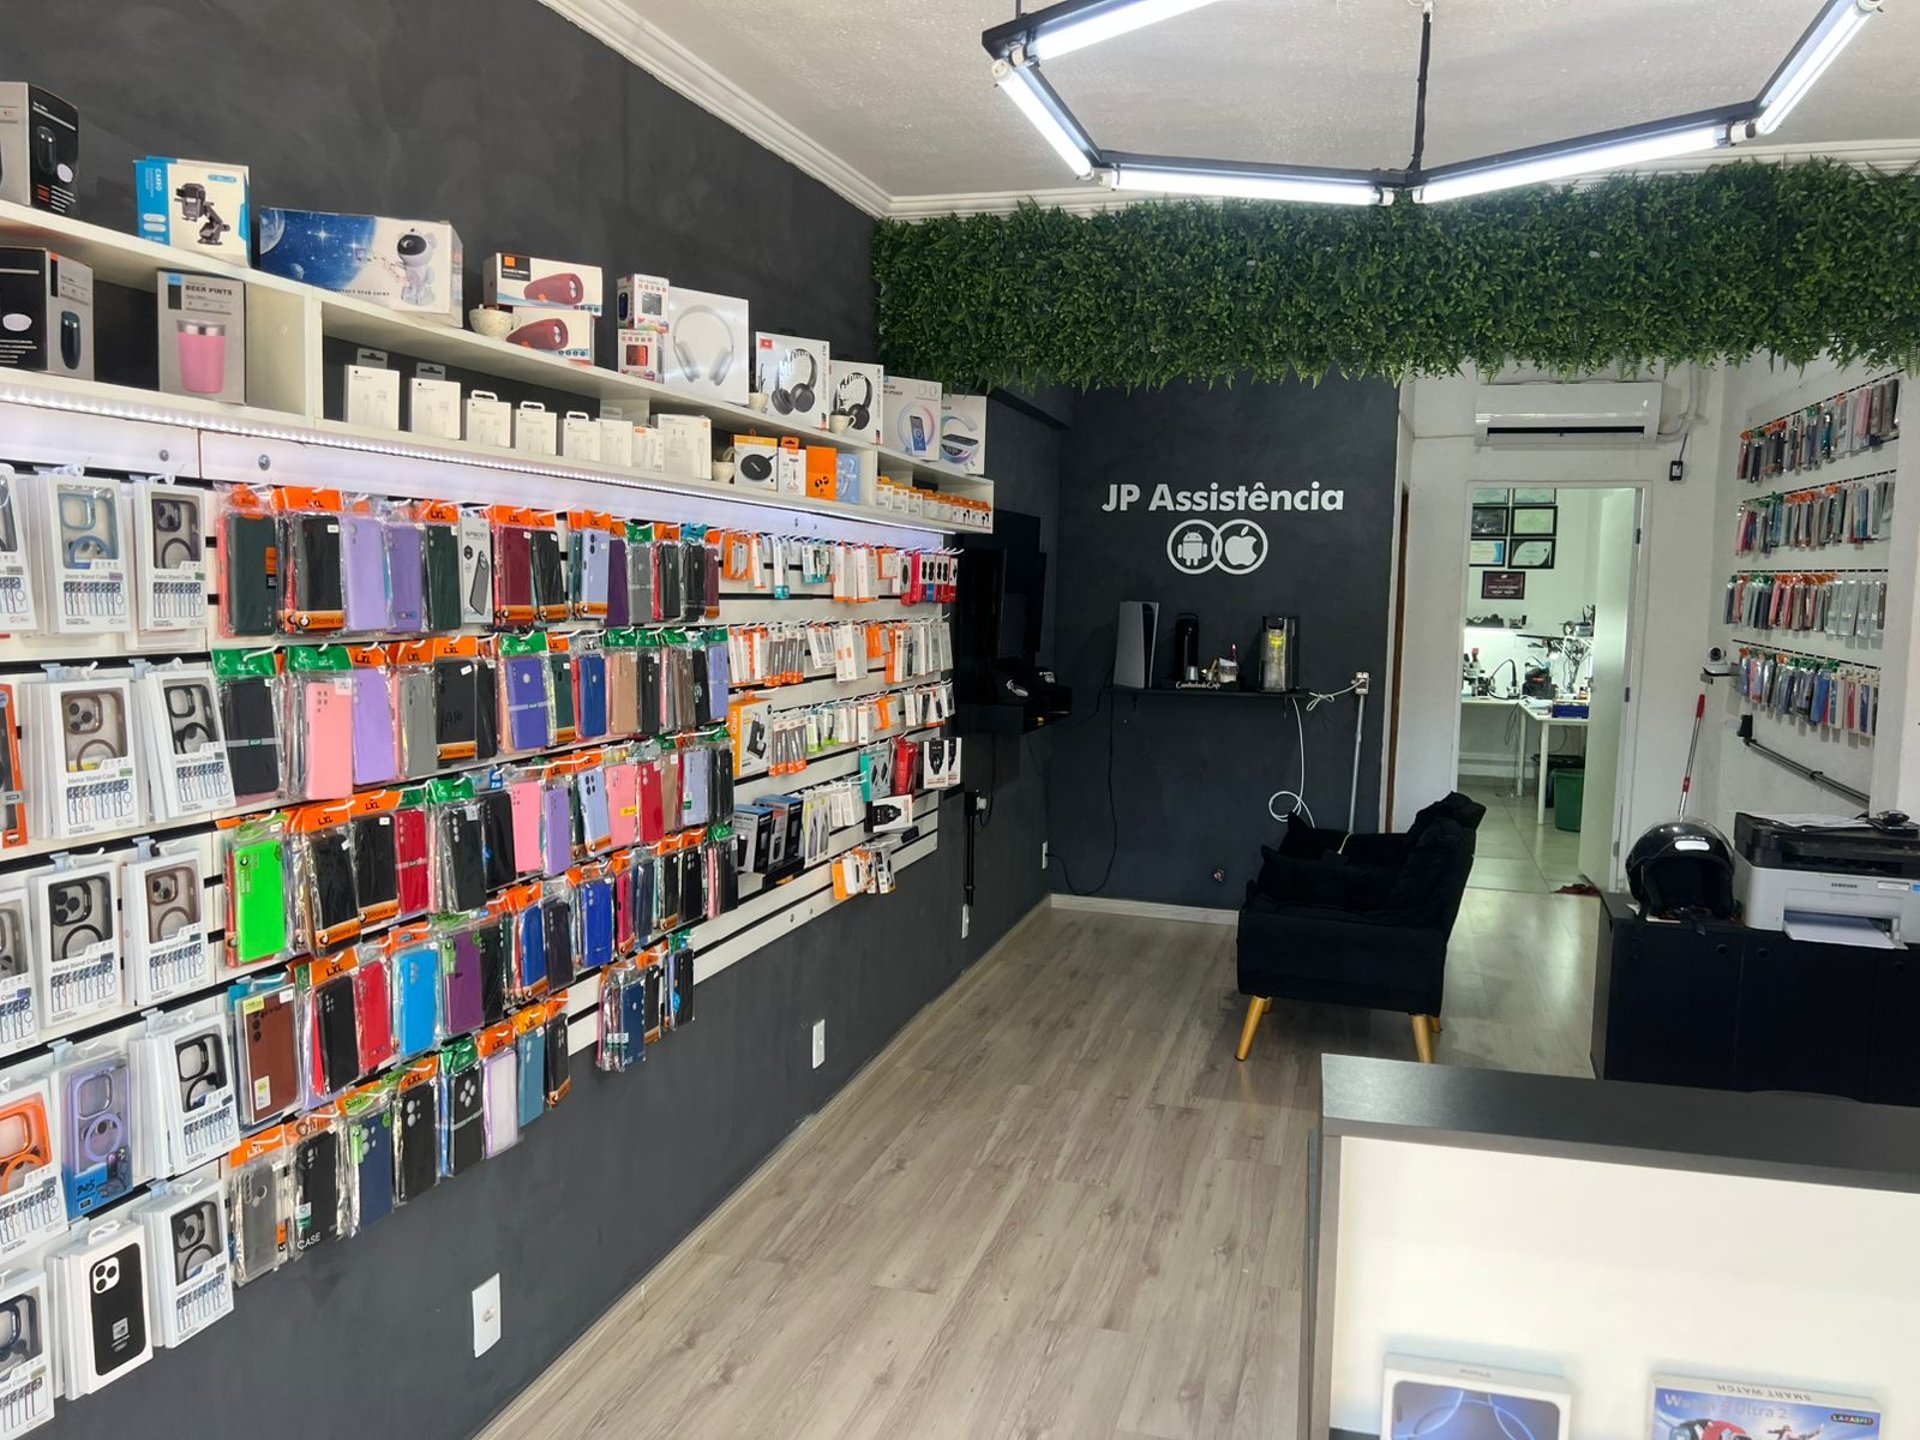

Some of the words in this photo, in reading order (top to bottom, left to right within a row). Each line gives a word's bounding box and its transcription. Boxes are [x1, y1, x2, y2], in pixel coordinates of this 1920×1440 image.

[185, 284, 207, 292] BEER
[208, 287, 233, 296] PINTS
[1101, 483, 1141, 512] JP
[1148, 481, 1344, 512] Assistência
[444, 646, 459, 654] LXL
[355, 653, 371, 664] LXL
[407, 652, 420, 662] LXL
[365, 801, 380, 811] LXL
[317, 814, 334, 826] LXL
[326, 963, 343, 976] LXL
[297, 1231, 321, 1250] CASE
[1714, 1384, 1763, 1397] WATCH
[1766, 1388, 1813, 1401] SMART
[1735, 1402, 1774, 1417] Ultra
[1776, 1407, 1788, 1420] 2
